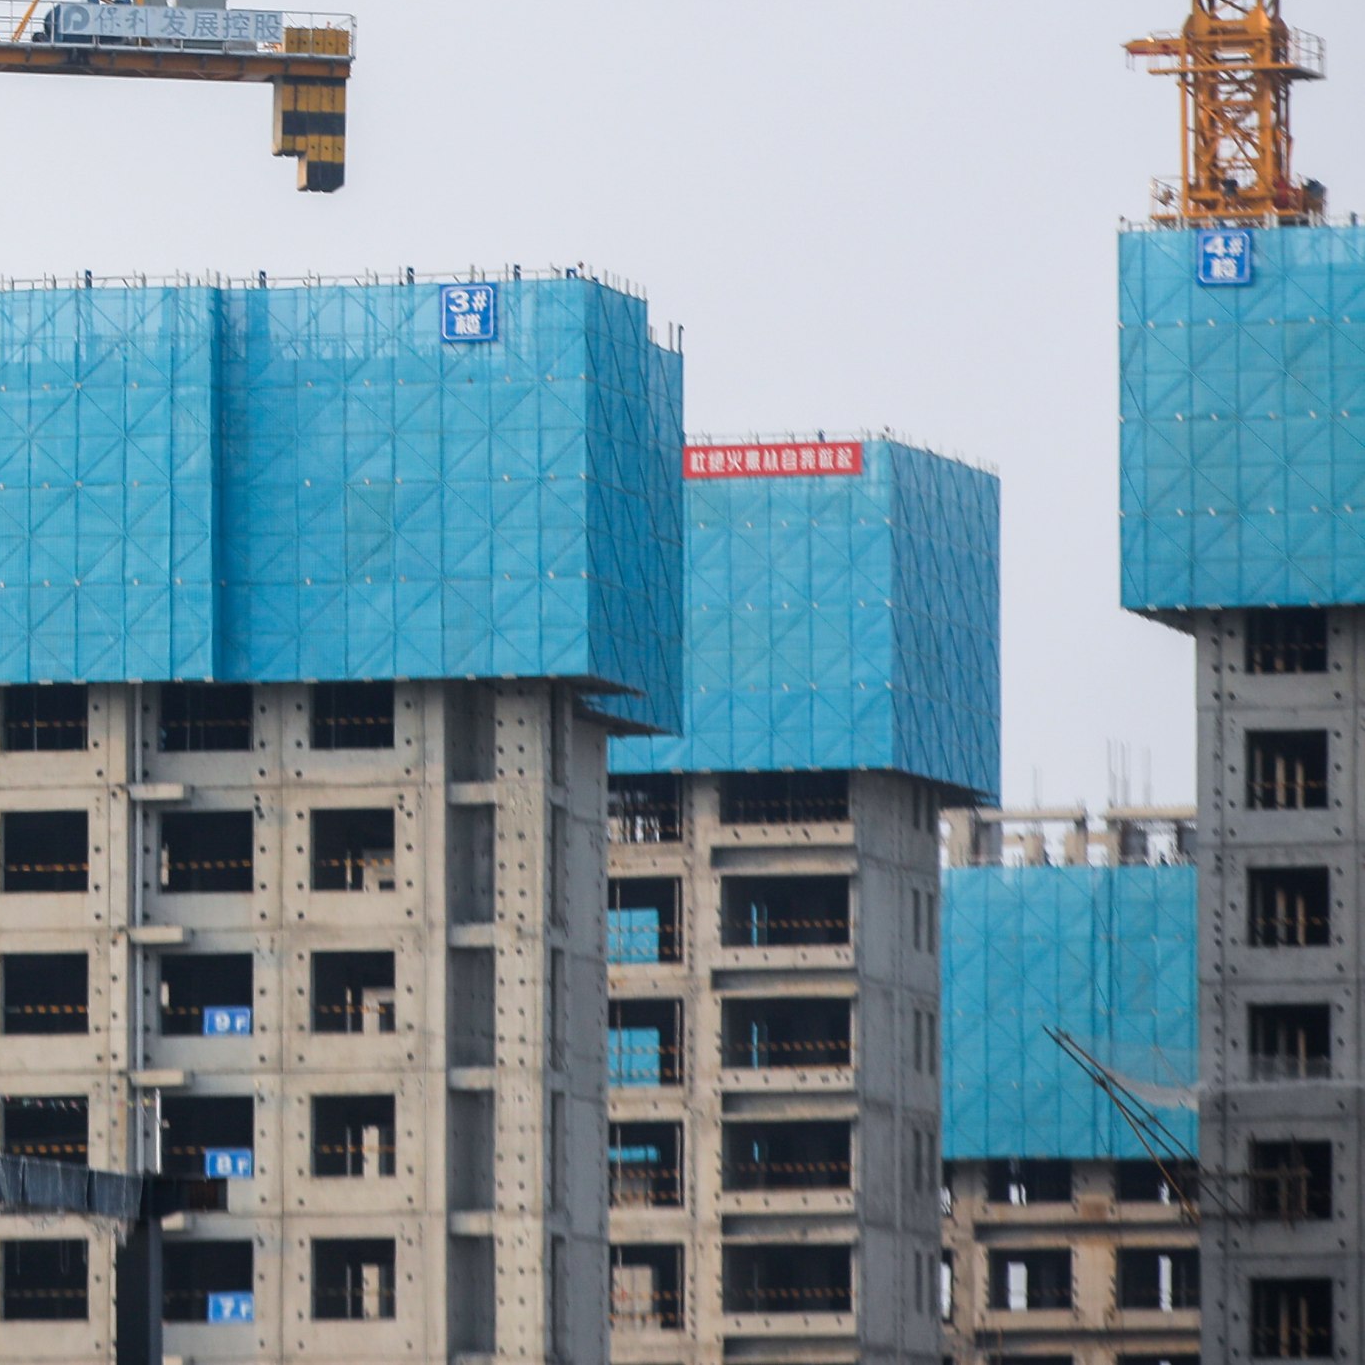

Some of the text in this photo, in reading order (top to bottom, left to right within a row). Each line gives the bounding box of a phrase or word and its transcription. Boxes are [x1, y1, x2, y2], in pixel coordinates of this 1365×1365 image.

[94, 4, 283, 41] 保利发展控股
[448, 290, 488, 312] 3#
